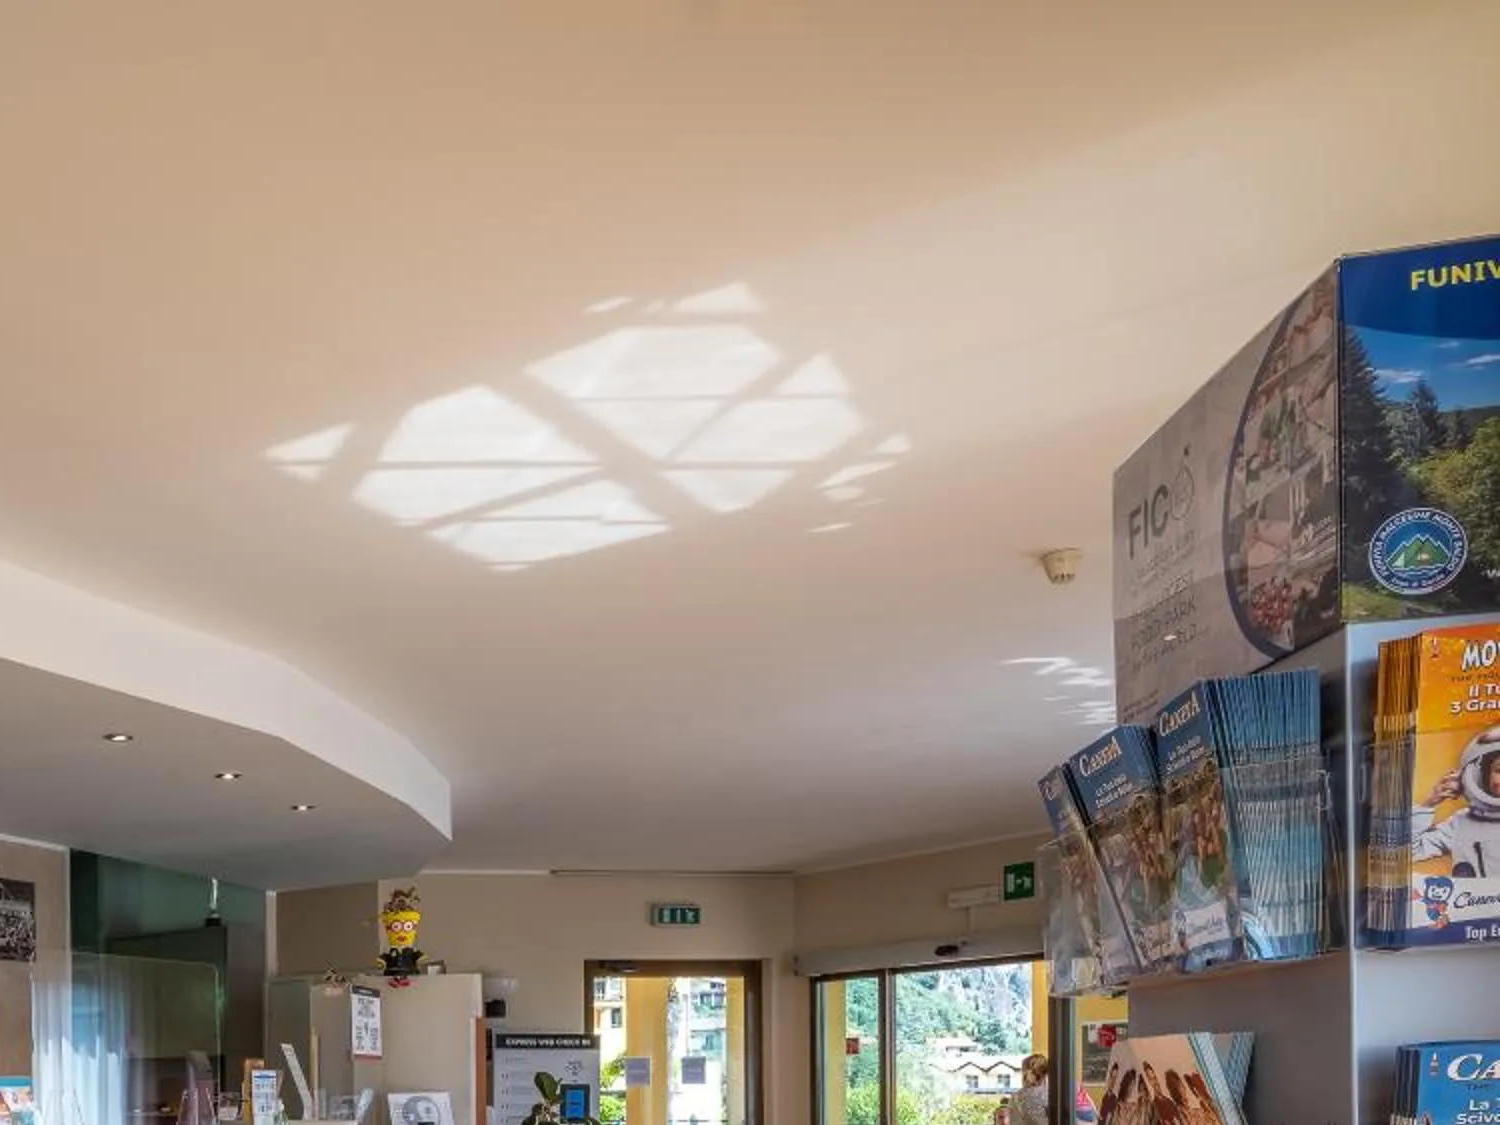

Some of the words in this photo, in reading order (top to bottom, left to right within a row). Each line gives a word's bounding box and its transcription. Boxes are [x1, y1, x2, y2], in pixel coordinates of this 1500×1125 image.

[1461, 640, 1500, 671] MO
[1451, 702, 1460, 713] 3
[1464, 925, 1487, 941] Top
[1469, 1099, 1489, 1111] La
